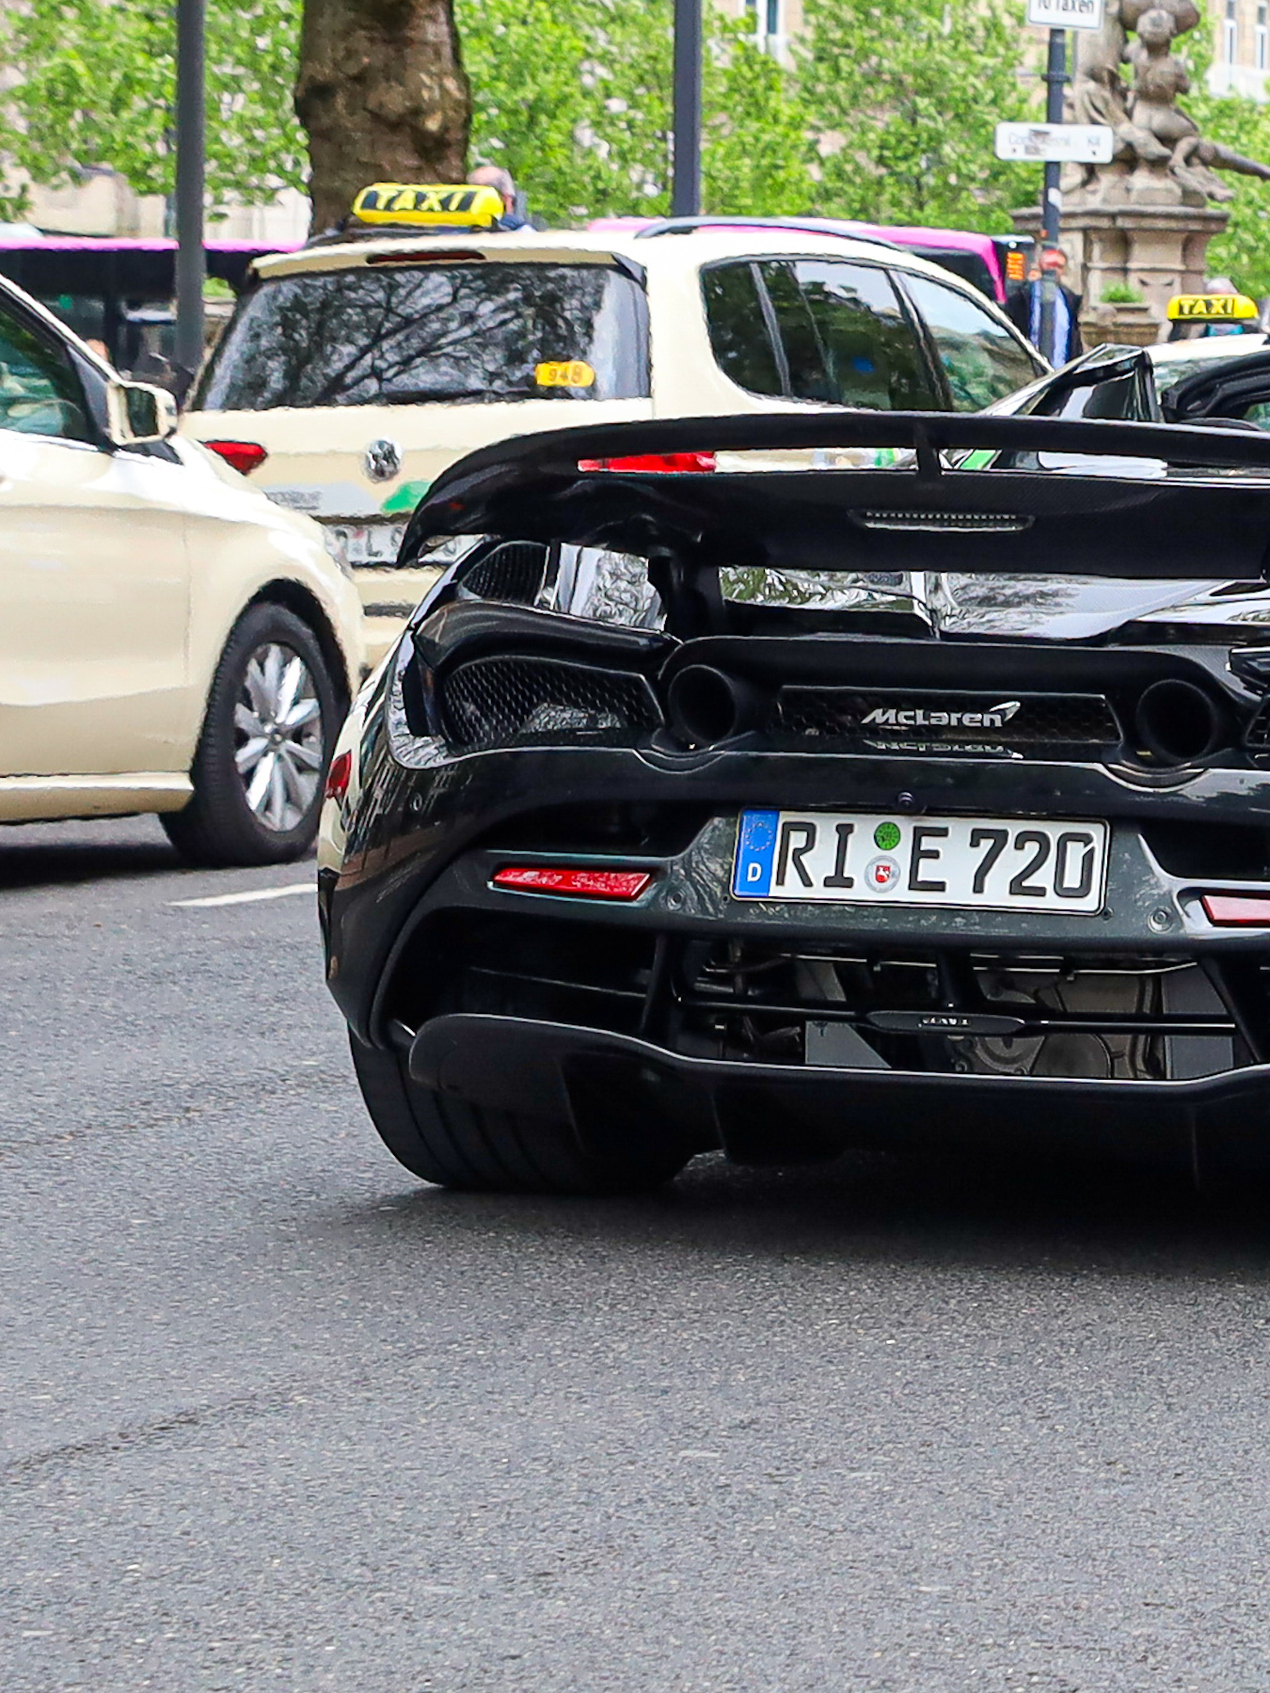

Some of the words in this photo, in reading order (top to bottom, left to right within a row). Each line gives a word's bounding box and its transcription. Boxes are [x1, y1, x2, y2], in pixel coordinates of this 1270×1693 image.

[375, 190, 464, 212] TAXI
[1180, 298, 1233, 315] TAXI
[861, 708, 1003, 727] McLaren
[776, 821, 855, 888] RI
[908, 826, 949, 892] E
[969, 828, 1096, 898] 720
[747, 863, 762, 882] D
